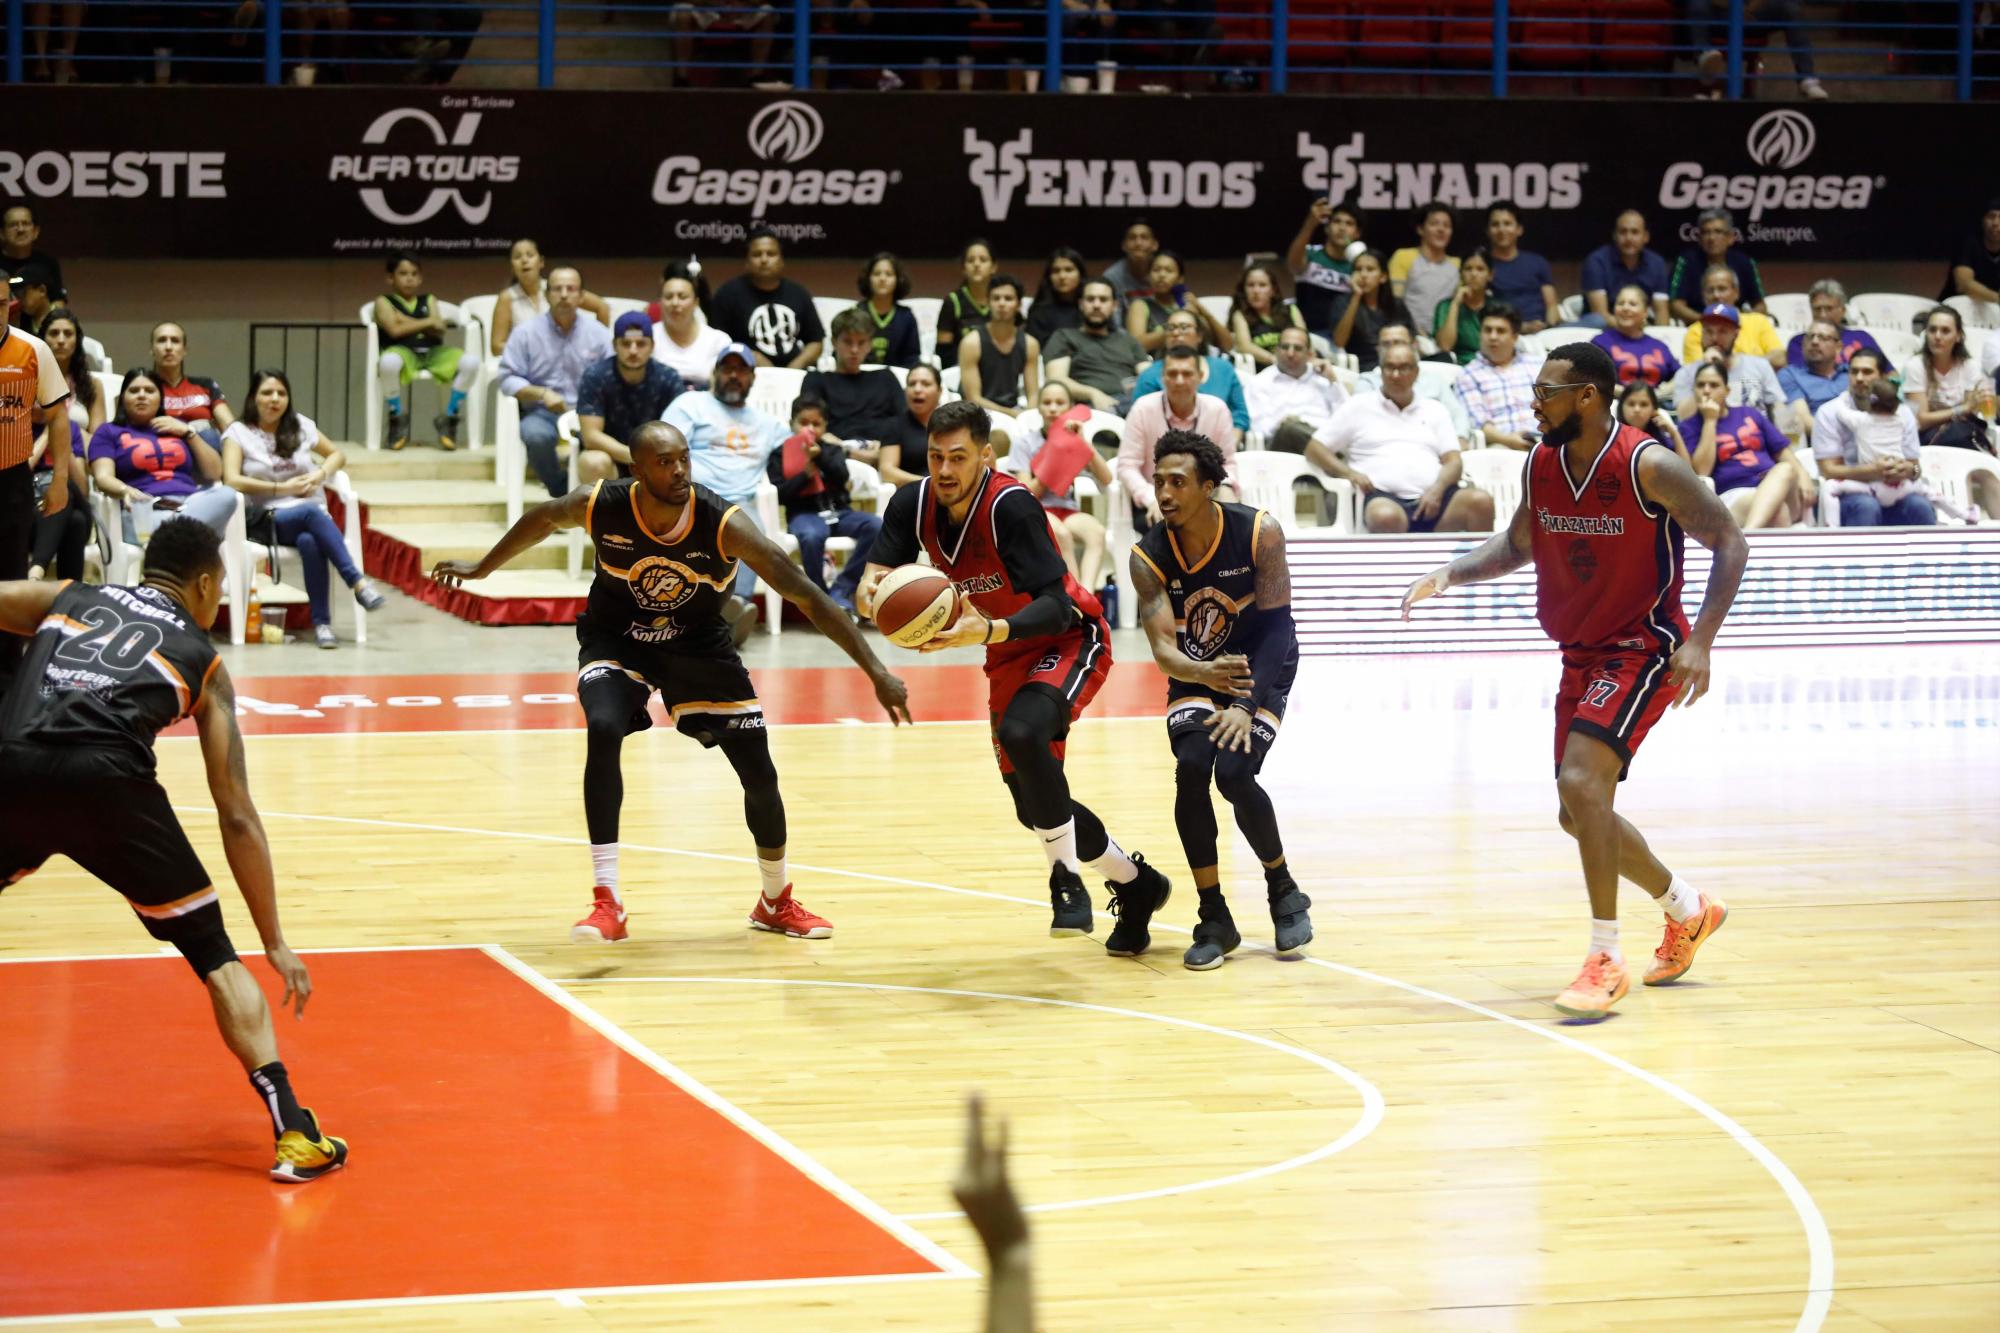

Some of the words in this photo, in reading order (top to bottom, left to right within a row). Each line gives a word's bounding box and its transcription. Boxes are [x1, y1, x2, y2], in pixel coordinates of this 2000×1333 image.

[329, 155, 412, 181] ALFA
[414, 155, 520, 181] TOURS
[652, 155, 888, 219] Gaspasa
[963, 128, 1257, 221] VENADOS
[1297, 132, 1583, 210] VENADOS
[1658, 161, 1873, 223] Gaspasa
[1550, 513, 1625, 536] MAZATLÁN
[54, 605, 164, 671] 20
